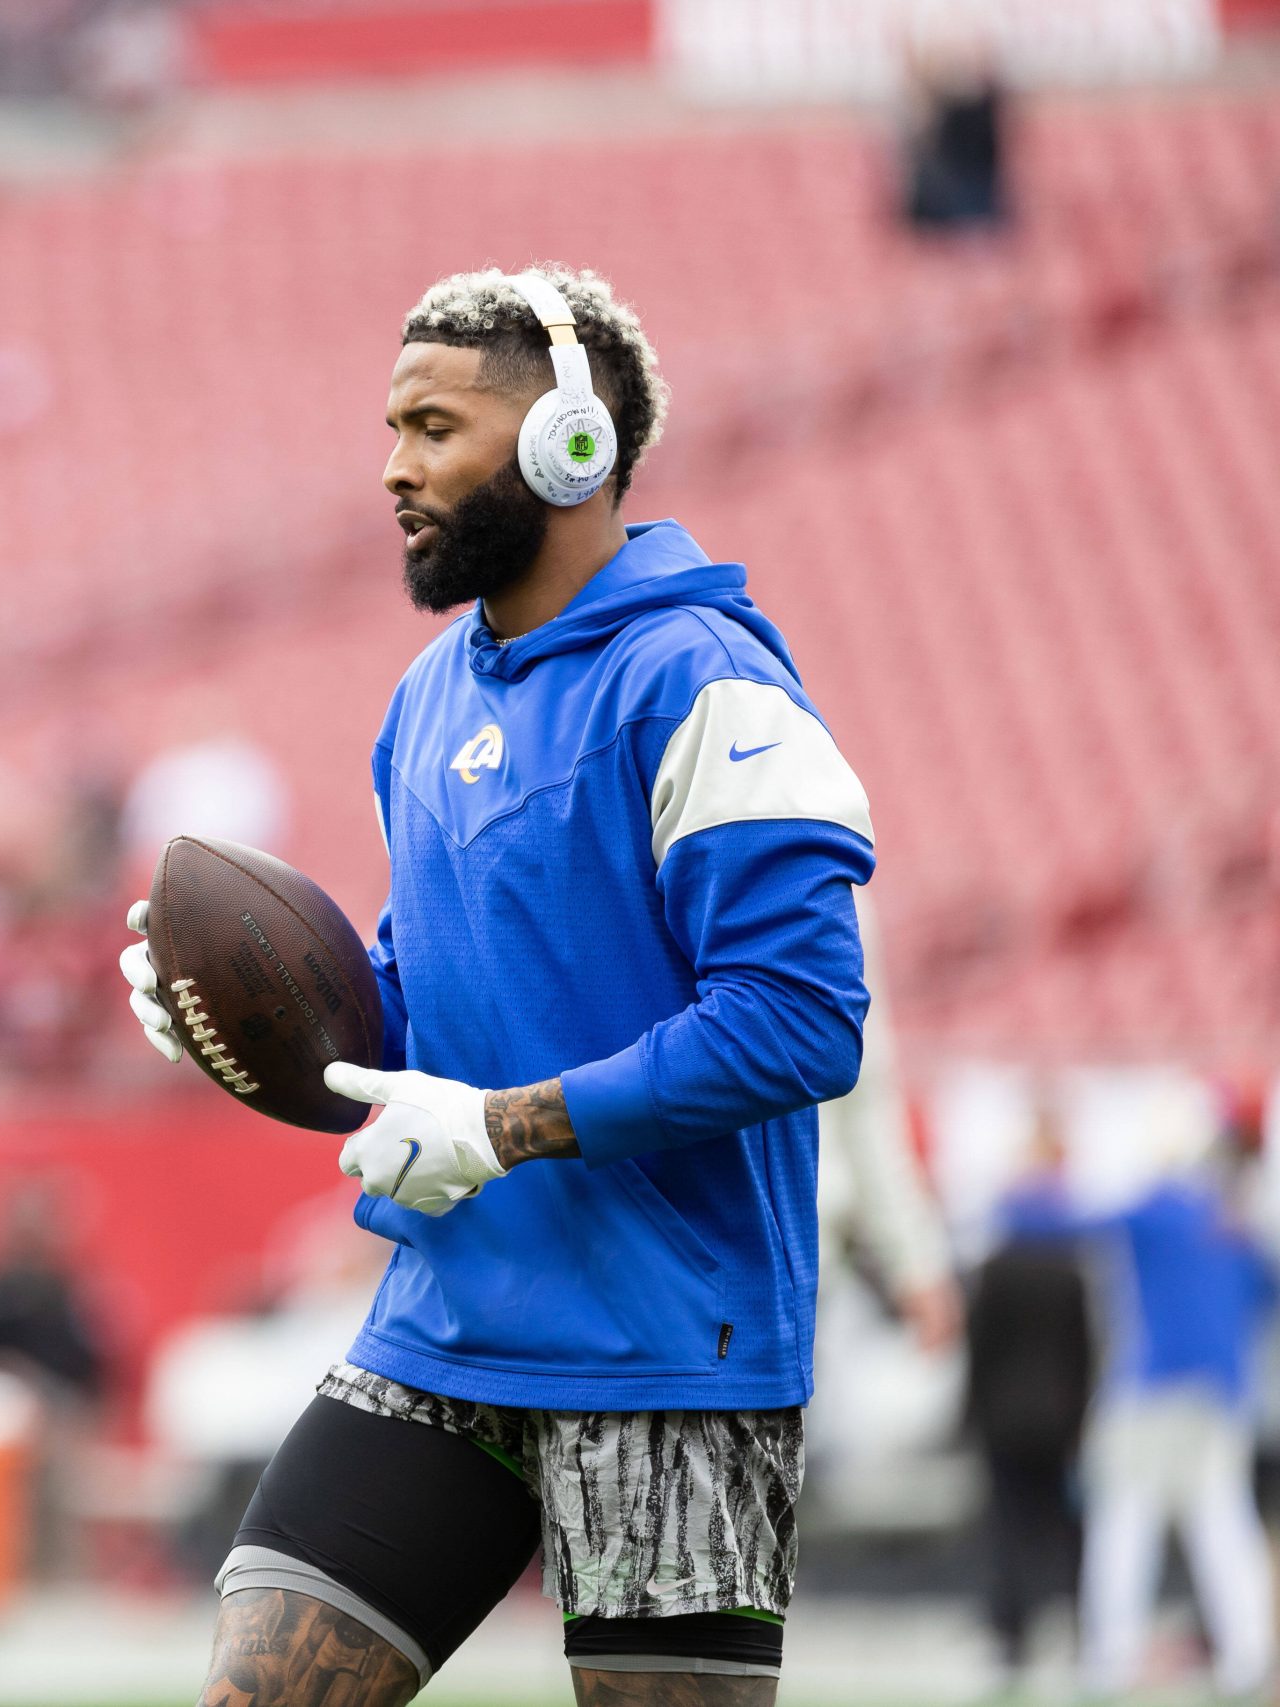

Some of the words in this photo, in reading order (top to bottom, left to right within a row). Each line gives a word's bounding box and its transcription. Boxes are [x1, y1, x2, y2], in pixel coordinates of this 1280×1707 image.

[240, 911, 277, 960] LEAGUE
[276, 962, 318, 1024] FOOTBALL
[302, 953, 341, 1013] Wilson
[317, 1026, 340, 1059] IONAL
